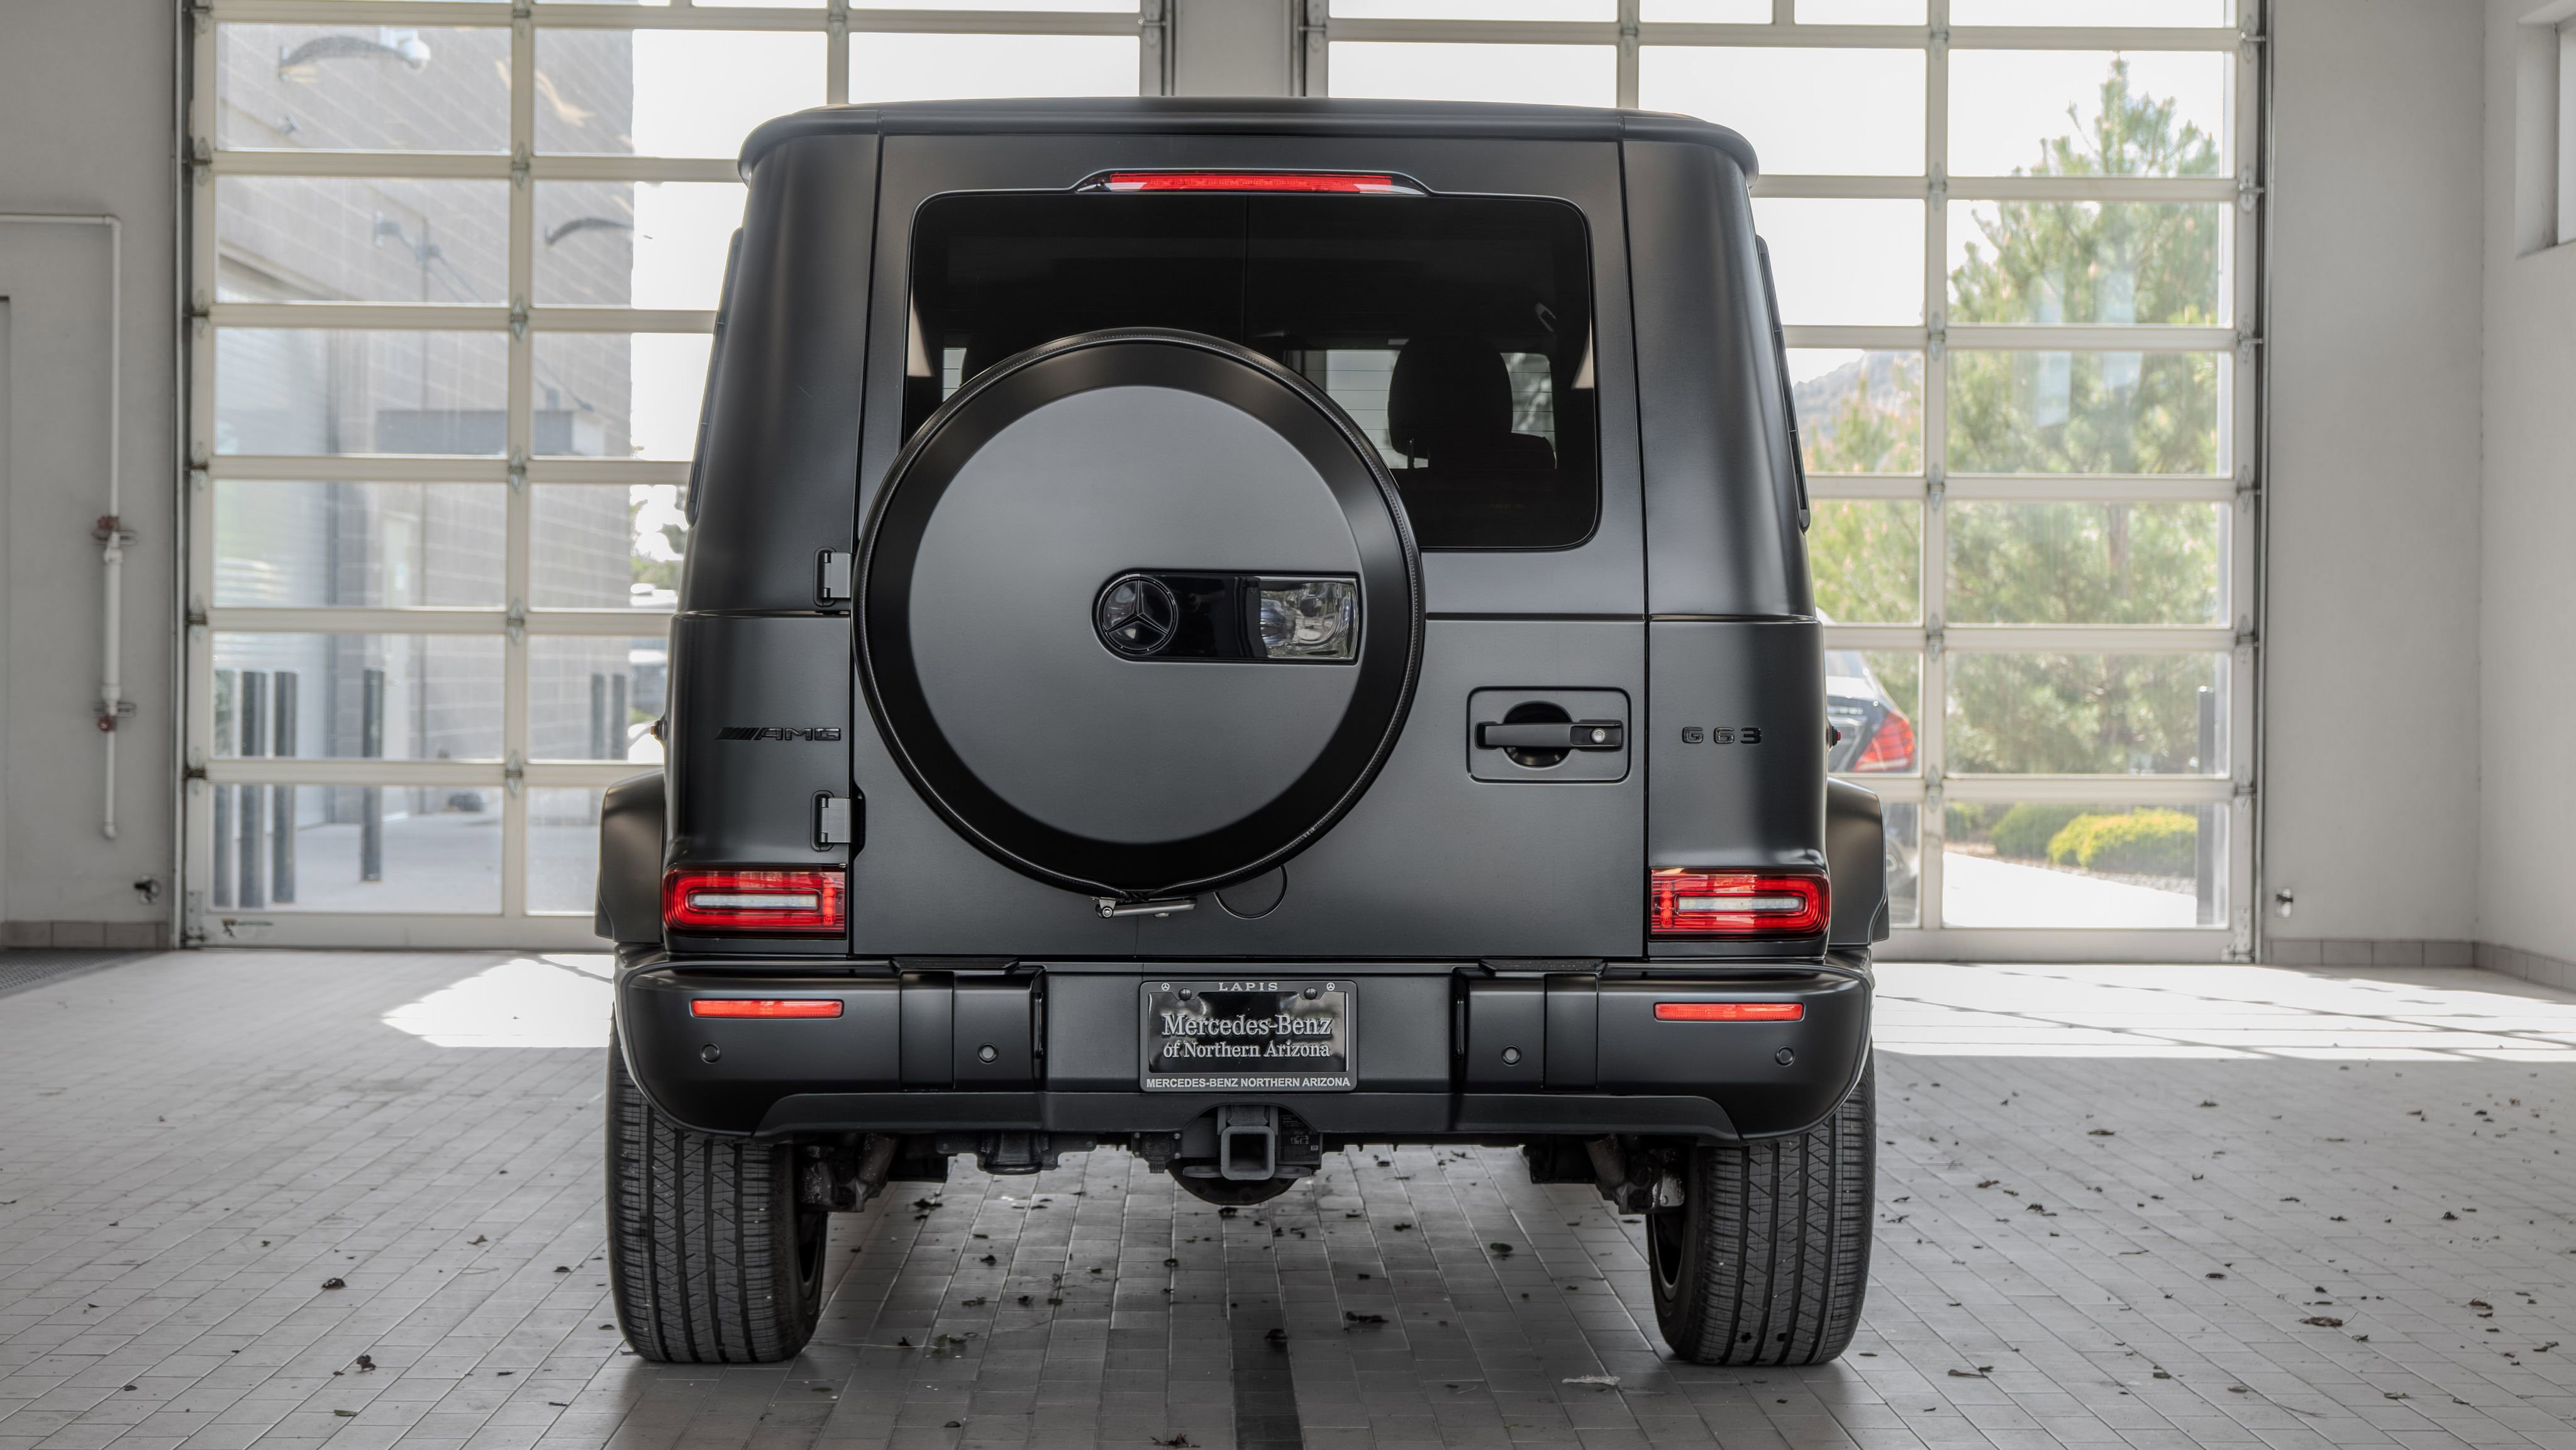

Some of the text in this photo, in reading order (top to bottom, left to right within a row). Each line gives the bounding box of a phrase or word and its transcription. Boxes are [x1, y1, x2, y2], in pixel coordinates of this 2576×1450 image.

[753, 727, 841, 741] AMG
[1218, 982, 1279, 991] LAPIS
[1161, 1014, 1333, 1037] Mercedes-Benz
[1162, 1042, 1331, 1058] of Northern Arizona
[1146, 1078, 1351, 1087] MERCEDES-BENZ NORTHERN ARIZONA
